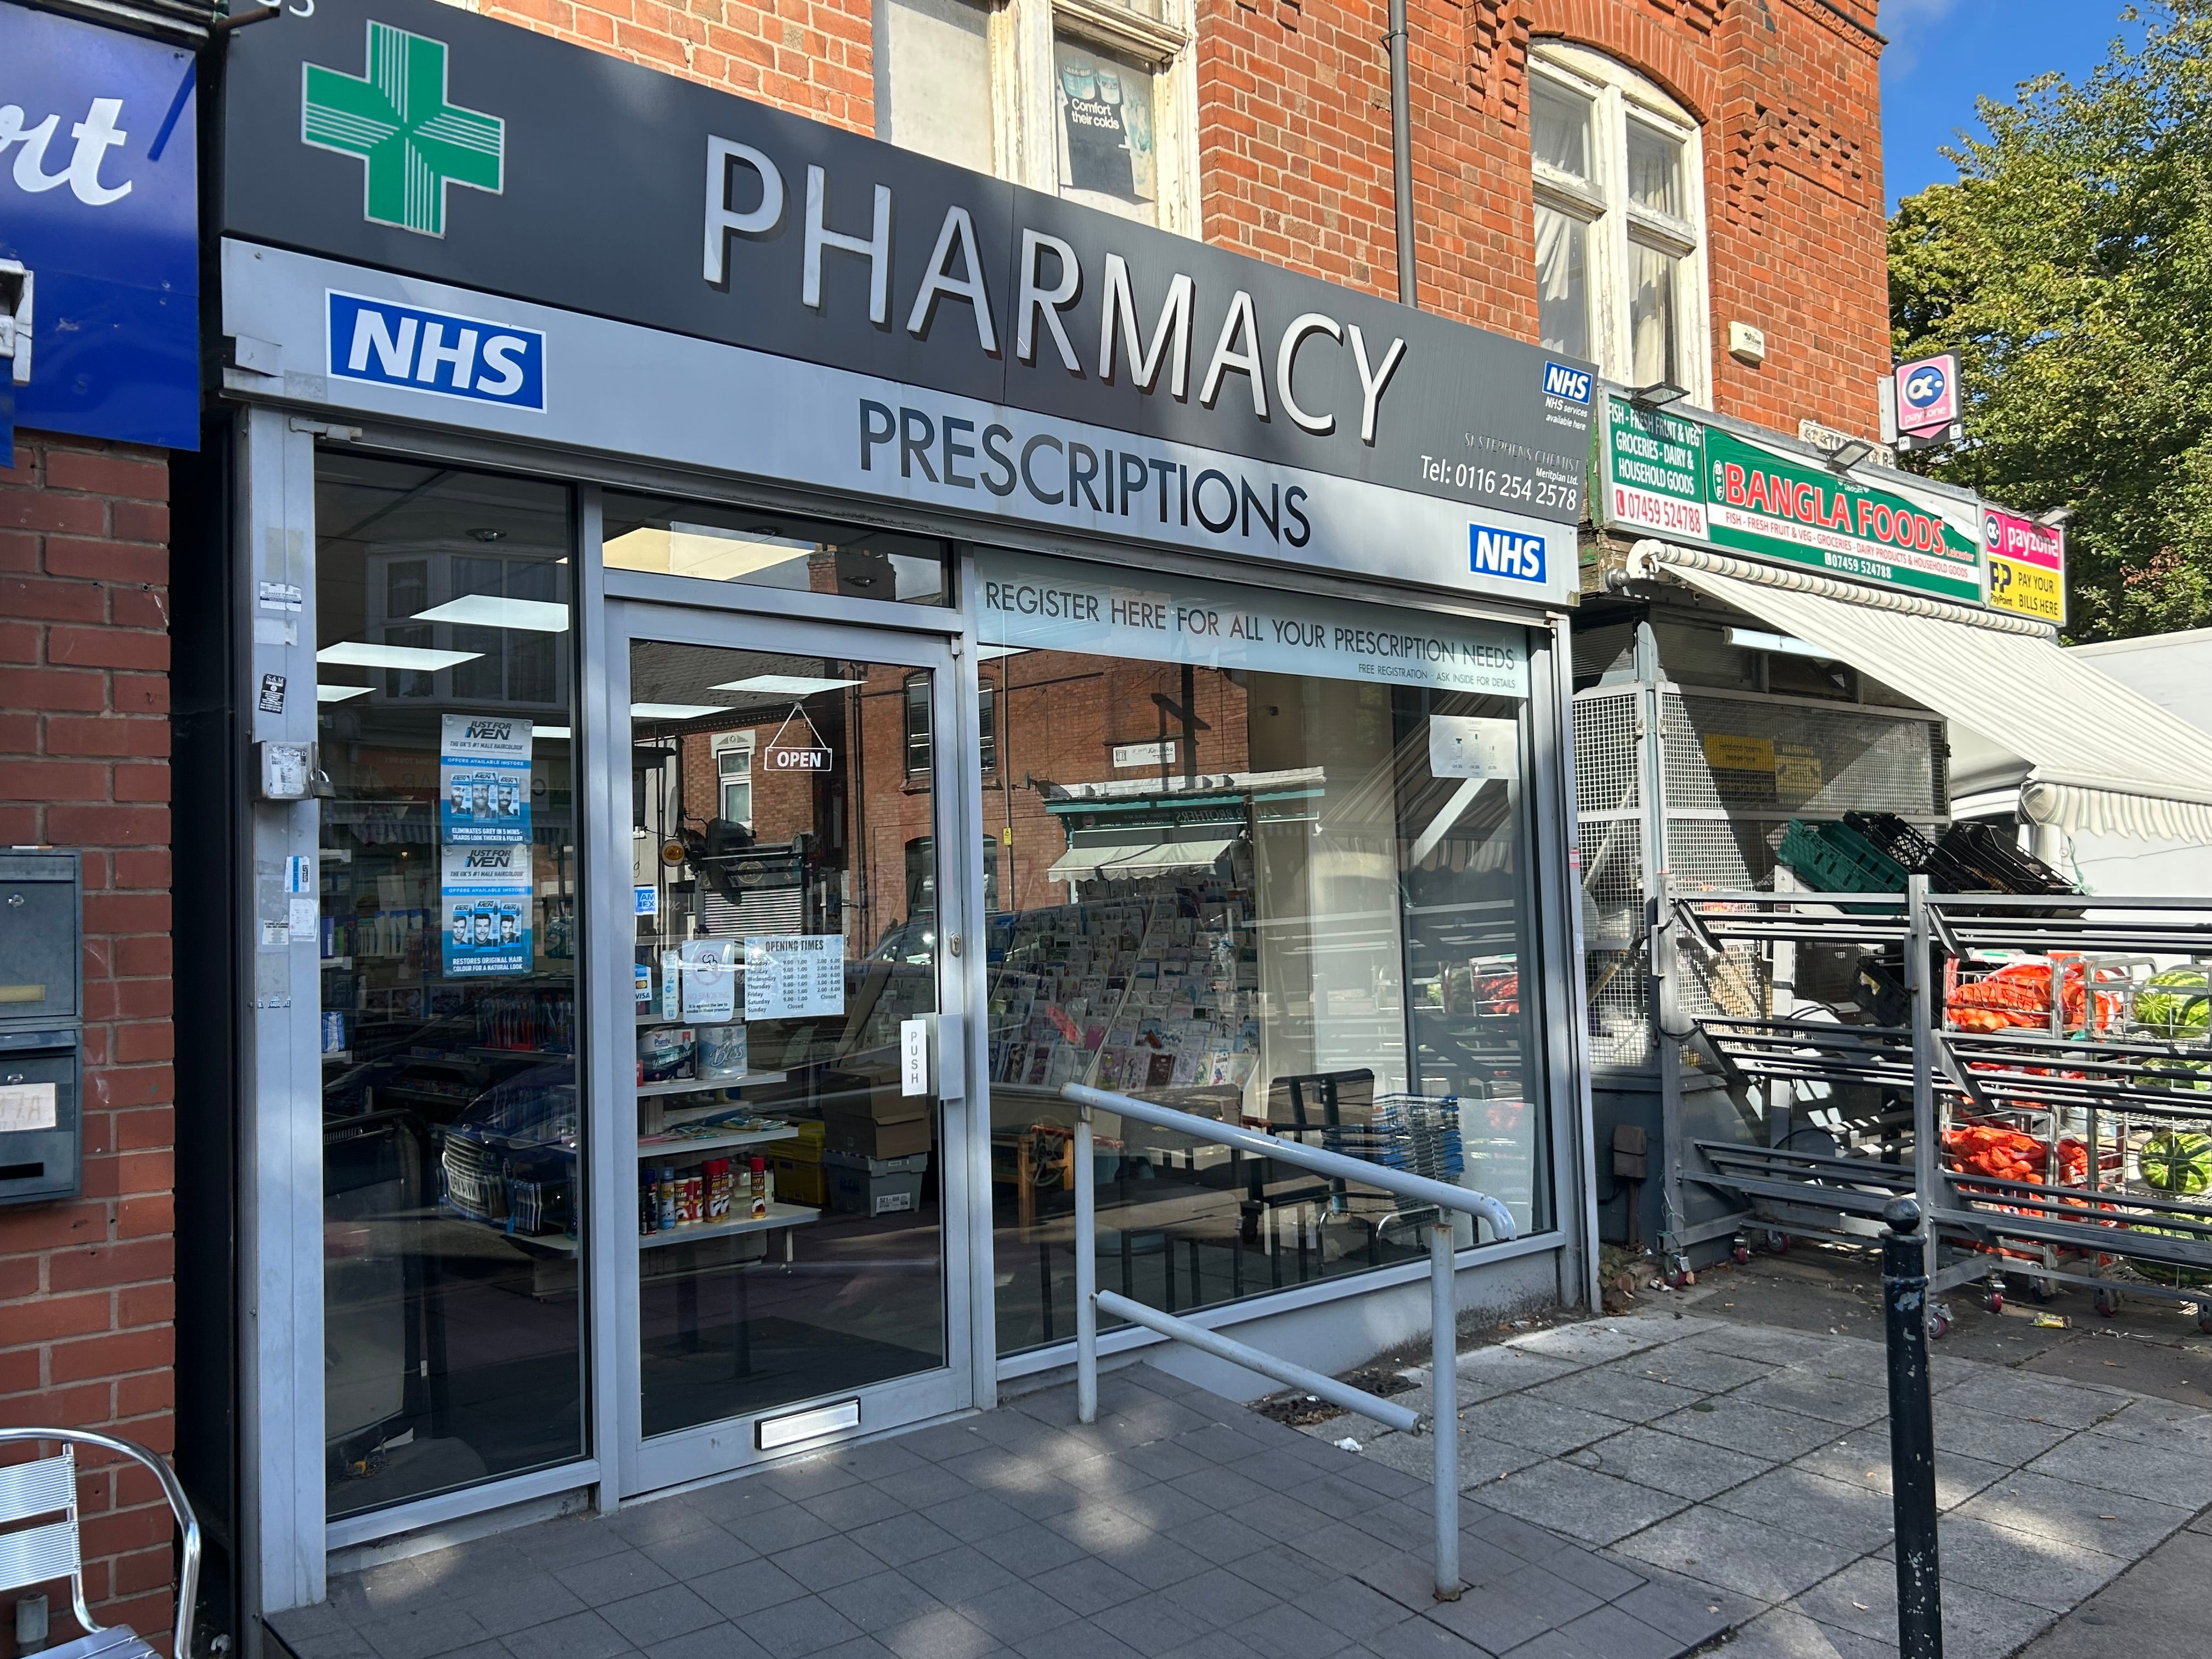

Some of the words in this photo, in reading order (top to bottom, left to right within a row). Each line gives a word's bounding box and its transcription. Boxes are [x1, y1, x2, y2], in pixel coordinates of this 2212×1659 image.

[1071, 98, 1111, 116] Comfort
[1071, 110, 1092, 126] their
[1093, 116, 1120, 129] colds
[703, 133, 1407, 442] PHARMACY
[348, 308, 528, 396] NHS
[1546, 366, 1589, 400] NHS
[1545, 396, 1564, 411] NHS
[1563, 404, 1588, 418] services
[1545, 413, 1573, 428] available
[1573, 419, 1587, 432] here
[1608, 402, 1624, 425] FISH
[1629, 408, 1654, 435] FRESH
[1655, 416, 1677, 439] FRUIT
[1678, 423, 1684, 440] &
[1684, 425, 1700, 448] VEG
[1478, 435, 1533, 462] STEPHENS
[1534, 449, 1582, 473] CHEMIST
[1616, 430, 1658, 460] GROCERIES
[1663, 444, 1686, 469] DAIRY
[1687, 452, 1695, 470] &
[859, 398, 1311, 548] PRESCRIPTIONS
[1421, 455, 1451, 484] Tel:
[1455, 463, 1496, 494] 0116
[1499, 473, 1532, 501] 254
[1536, 482, 1577, 511] 2578
[1536, 466, 1566, 483] Meritplan
[1566, 473, 1579, 486] Ltd.
[1618, 456, 1666, 488] HOUSEHOLD
[1667, 470, 1695, 496] GOODS
[1628, 491, 1661, 526] 07459
[1663, 499, 1701, 534] 524788
[1725, 461, 1853, 535] BANGLA
[1857, 496, 1946, 556] FOODS
[1475, 530, 1542, 578] NHS
[1725, 511, 1741, 527] FISH
[1747, 517, 1769, 532] FRESH
[1770, 521, 1790, 537] FRUIT
[1791, 526, 1797, 539] &
[1797, 528, 1812, 543] VEG
[1817, 534, 1852, 552] GROCERIES
[1857, 543, 1875, 557] DAIRY
[1875, 548, 1907, 565] PRODUCTS
[1908, 554, 1913, 566] &
[1914, 555, 1947, 574] HOUSEHOLD
[1948, 563, 1968, 579] GOODS
[2006, 524, 2059, 558] payzone
[1832, 554, 1859, 573] 07459
[1860, 559, 1892, 580] 524788
[2018, 572, 2032, 586] PAY
[2033, 574, 2054, 594] YOUR
[1990, 591, 2013, 608] PayPoint
[2019, 594, 2038, 611] BILLS
[2039, 598, 2058, 617] HERE
[985, 581, 1101, 623] REGISTER
[1110, 597, 1166, 630] HERE
[1177, 606, 1220, 637] FOR
[1229, 614, 1264, 642] ALL
[1271, 619, 1326, 648] YOUR
[1334, 627, 1455, 663] PRESCRIPTION
[1462, 642, 1515, 671] NEEDS
[1358, 663, 1375, 675] FREE
[1377, 664, 1428, 680] REGISTRATION
[1436, 672, 1451, 682] ASK
[1452, 674, 1475, 685] INSIDE
[1476, 676, 1490, 687] FOR
[1492, 678, 1516, 689] DETAILS
[465, 727, 511, 740] MEN
[470, 720, 493, 729] JUST
[776, 750, 822, 769] OPEN
[465, 856, 510, 867] MEN
[765, 940, 799, 952] OPENING
[800, 939, 824, 951] TIMES
[709, 1043, 744, 1067] Bliss
[910, 1031, 919, 1085] PUSH
